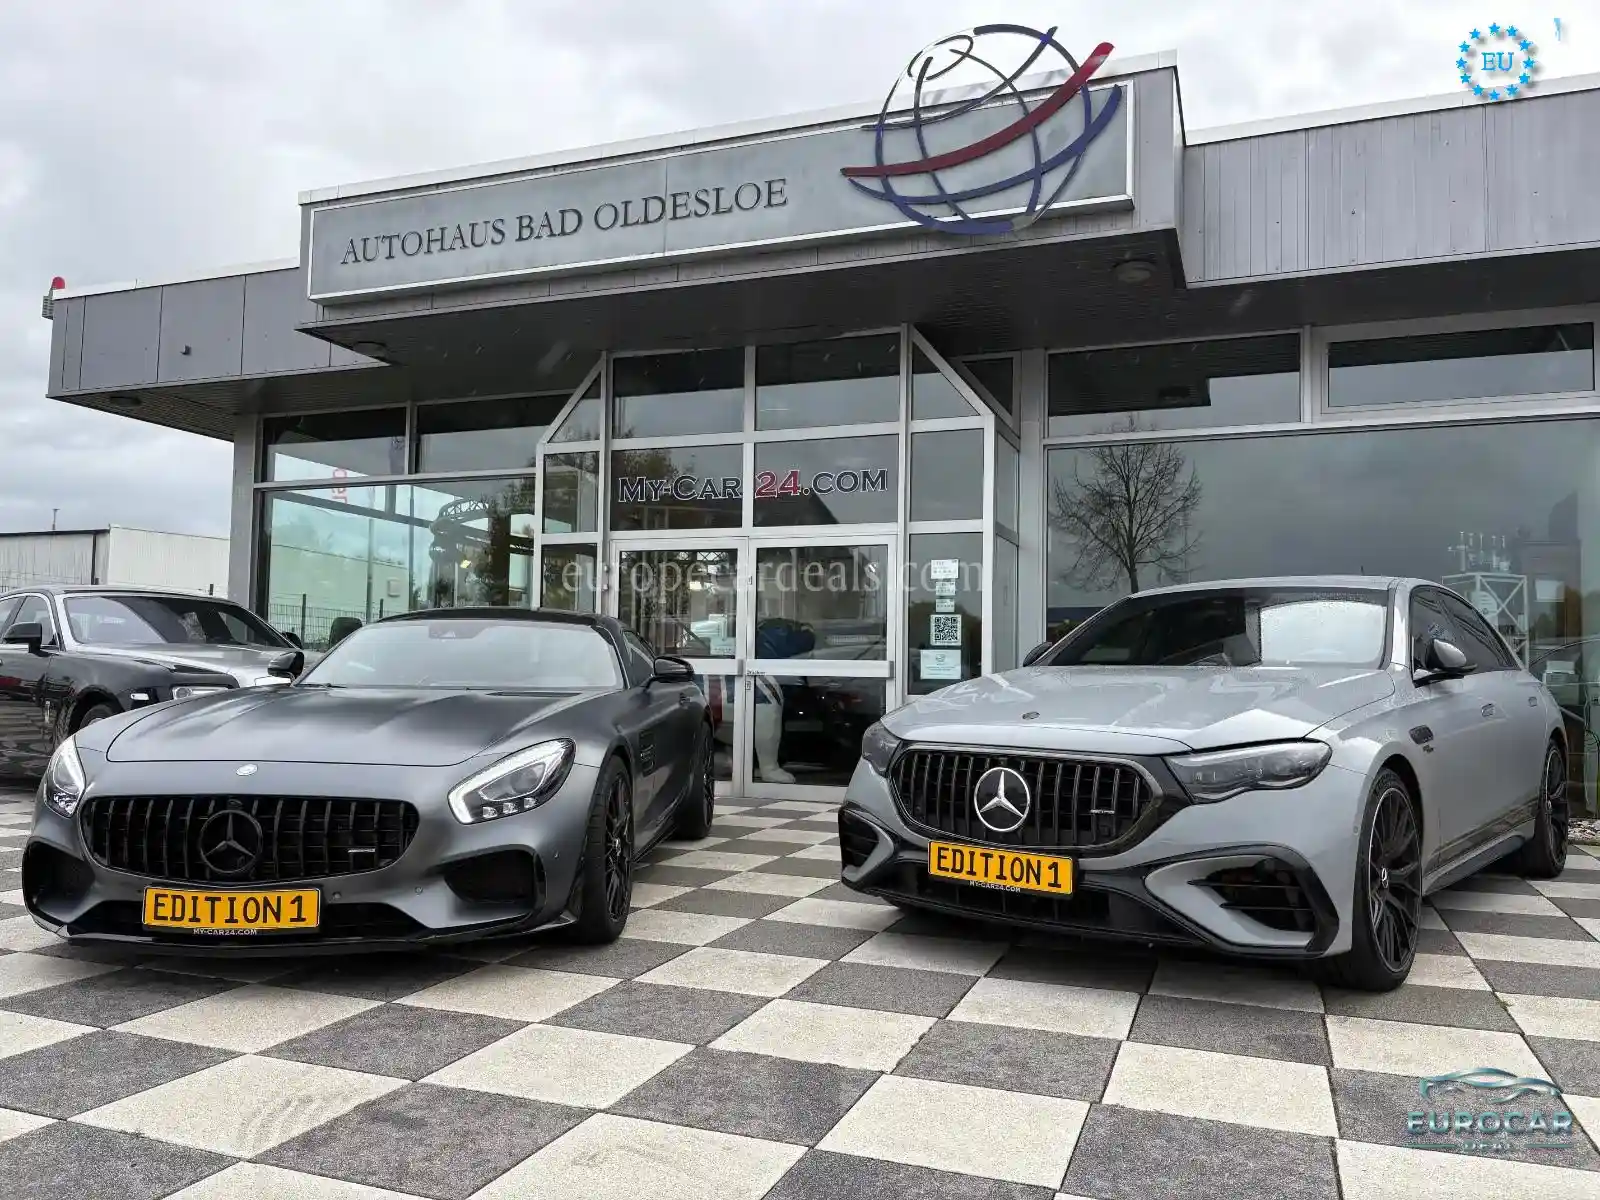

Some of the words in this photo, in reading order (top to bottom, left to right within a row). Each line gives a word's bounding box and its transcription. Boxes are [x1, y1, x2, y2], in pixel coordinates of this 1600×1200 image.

[340, 217, 506, 265] AUTOHAUS
[514, 207, 583, 242] BAD
[593, 178, 789, 231] OLDESLOE
[936, 846, 1042, 886] EDITION
[1047, 861, 1062, 889] 1
[153, 893, 282, 924] EDITION
[289, 895, 307, 923] 1
[193, 928, 258, 936] MY-CAR24.COM
